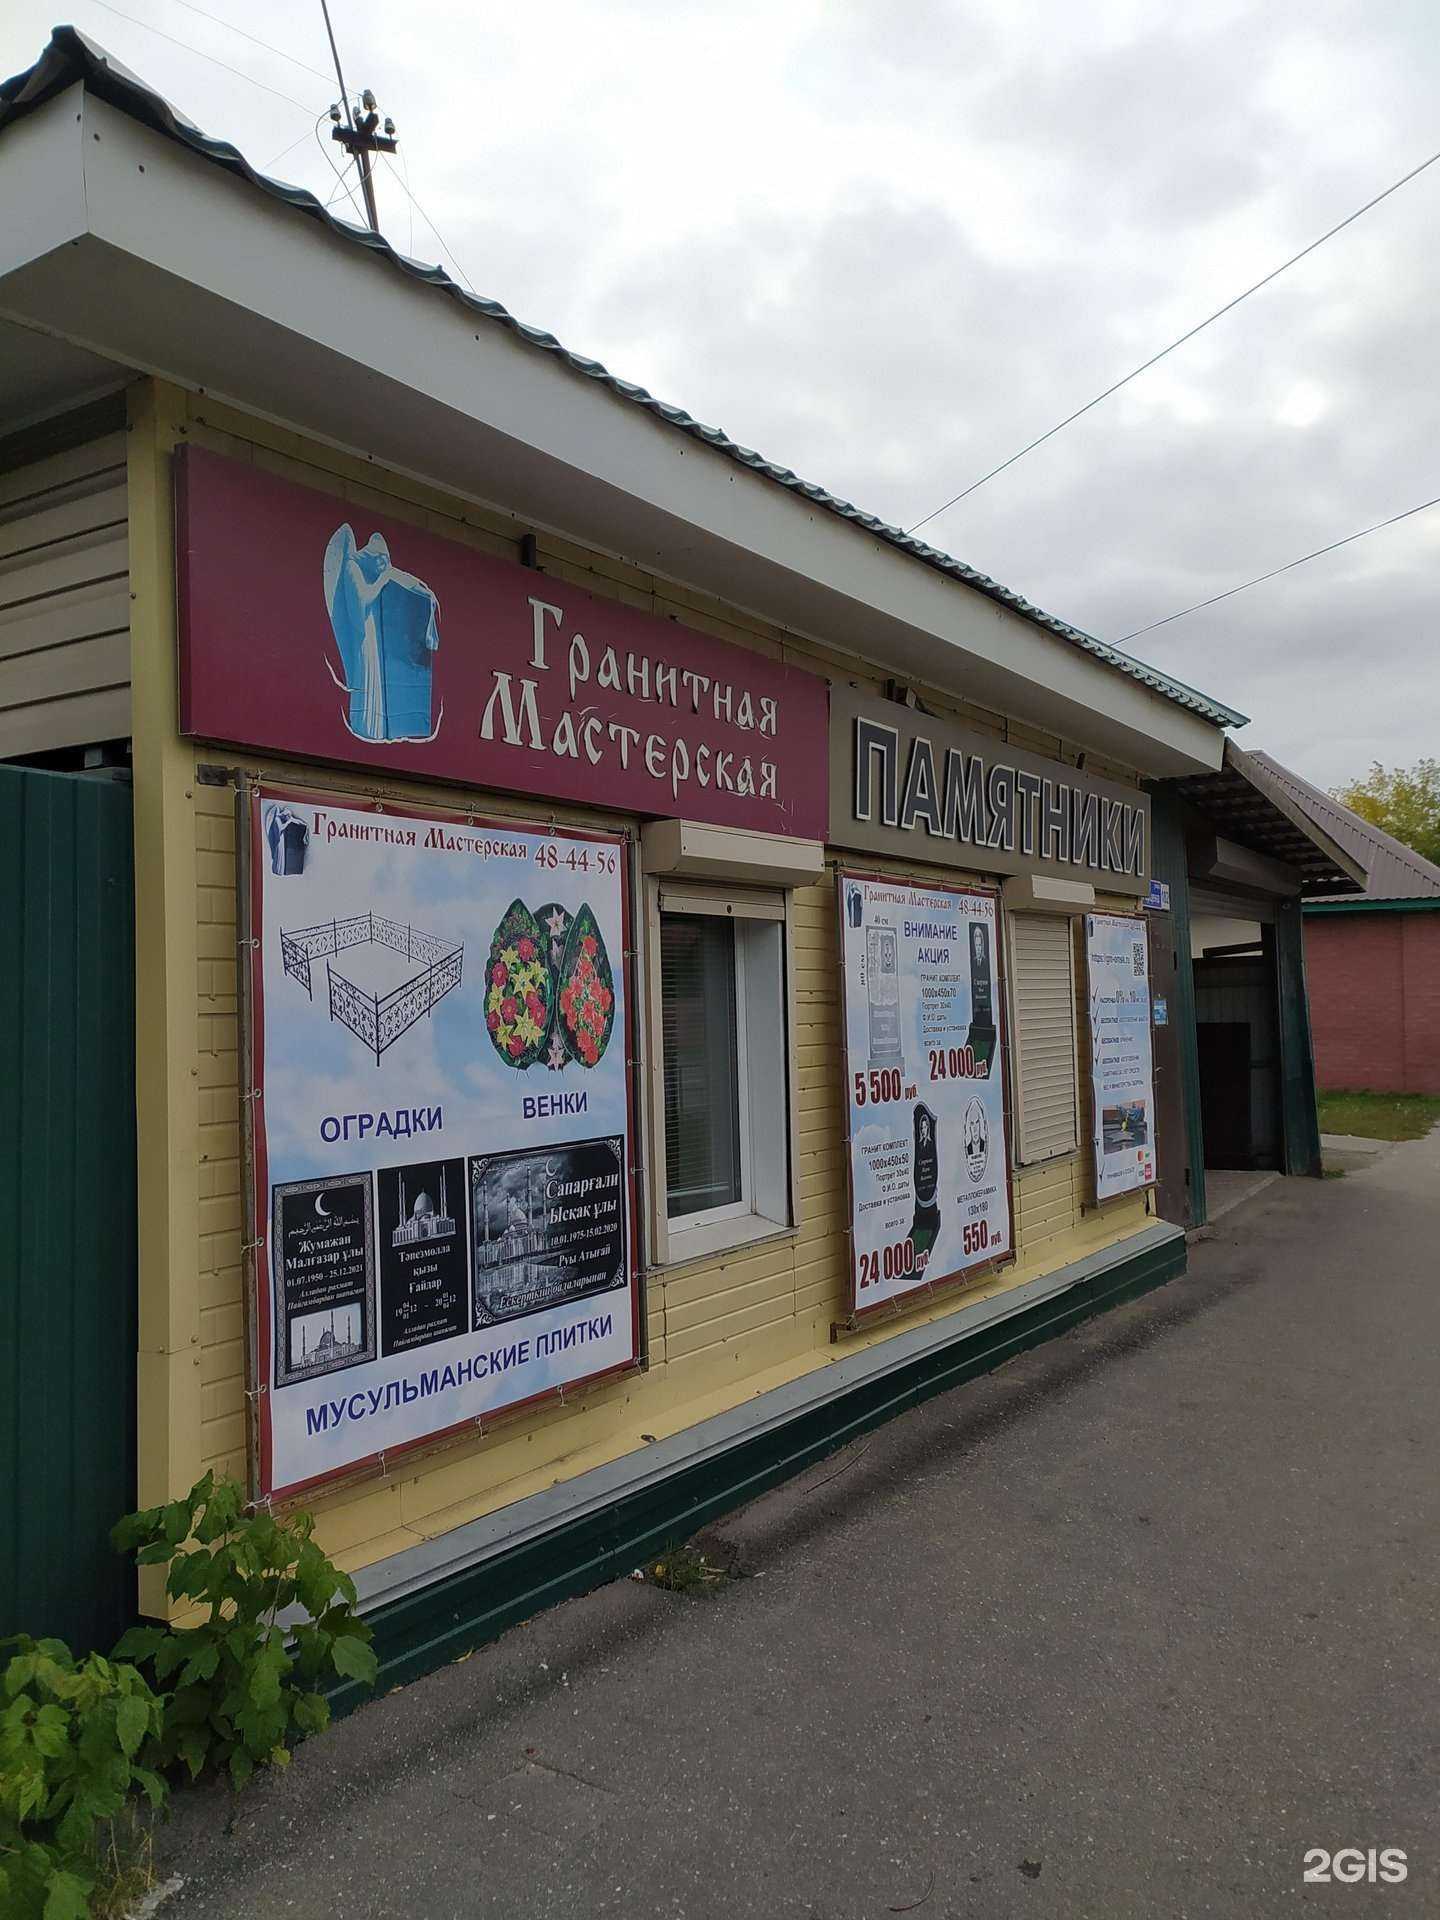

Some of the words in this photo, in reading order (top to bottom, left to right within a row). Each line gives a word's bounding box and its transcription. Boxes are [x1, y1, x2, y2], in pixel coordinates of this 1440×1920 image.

[526, 596, 779, 738] Гранитная
[479, 670, 779, 800] Мастерская
[855, 716, 1145, 877] ПАМЯТНИКИ
[312, 811, 416, 846] Гранитная
[424, 827, 528, 862] Мастерская
[534, 844, 616, 875] 48-44-56
[863, 884, 906, 905] Гранитная
[908, 890, 952, 911] Мастерская
[904, 921, 958, 941] ВНИМАНИЕ
[917, 948, 950, 966] АКЦИЯ
[929, 1050, 946, 1081] 24
[949, 1047, 974, 1078] 000
[523, 1092, 588, 1119] ВЕНКИ
[855, 1072, 867, 1106] 5
[870, 1069, 901, 1104] 500
[320, 1106, 443, 1143] ОГРАДКИ
[861, 1142, 882, 1155] ГРАНИТ
[547, 1173, 620, 1199] Сапарғали
[858, 1200, 882, 1213] Доставка
[963, 1219, 988, 1255] 550
[859, 1250, 880, 1288] 24
[884, 1239, 914, 1280] 000
[305, 1340, 530, 1435] МУСУЛЬМАНСКИЕ
[535, 1313, 613, 1359] ПЛИТКИ
